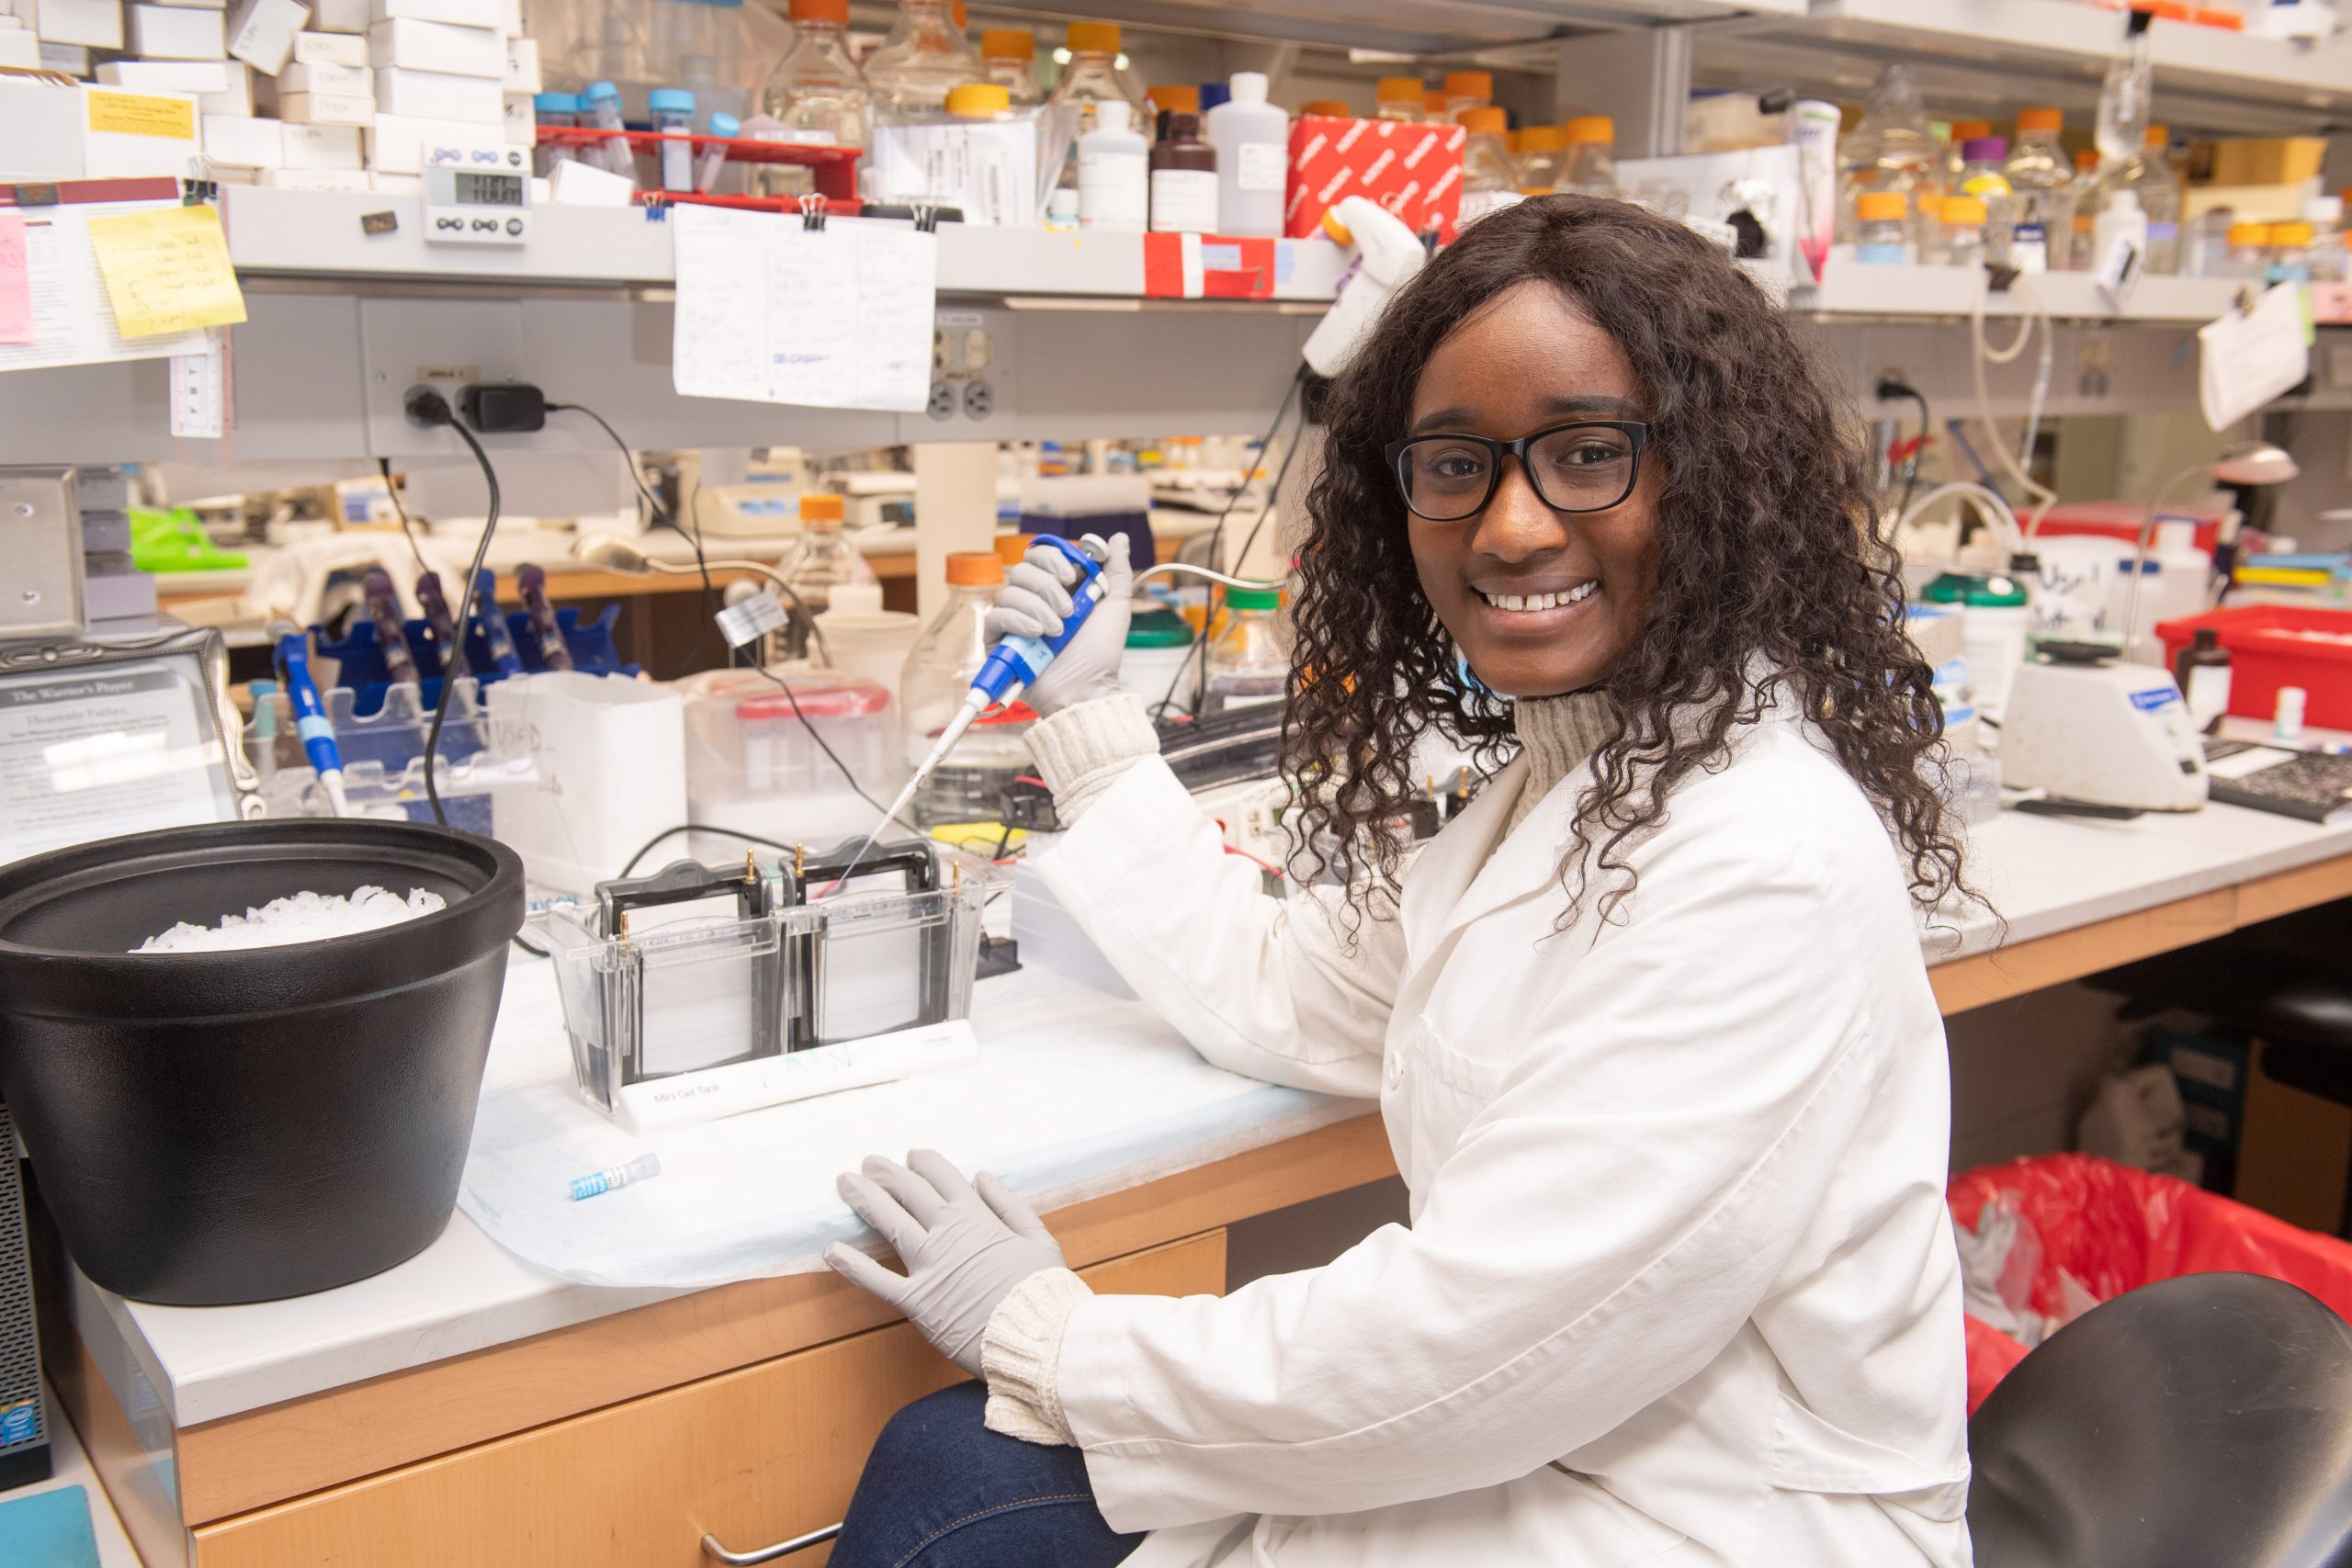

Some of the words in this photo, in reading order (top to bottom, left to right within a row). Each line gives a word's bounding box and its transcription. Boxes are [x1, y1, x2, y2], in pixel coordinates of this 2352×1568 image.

[1404, 131, 1440, 170] QIAGEN
[1317, 165, 1353, 204] QIAGEN
[12, 690, 38, 703] The
[39, 682, 96, 700] Warrior's
[96, 681, 135, 694] Prayer
[654, 1092, 676, 1104] Mini
[677, 1087, 695, 1100] Gel
[697, 1082, 721, 1094] Tank
